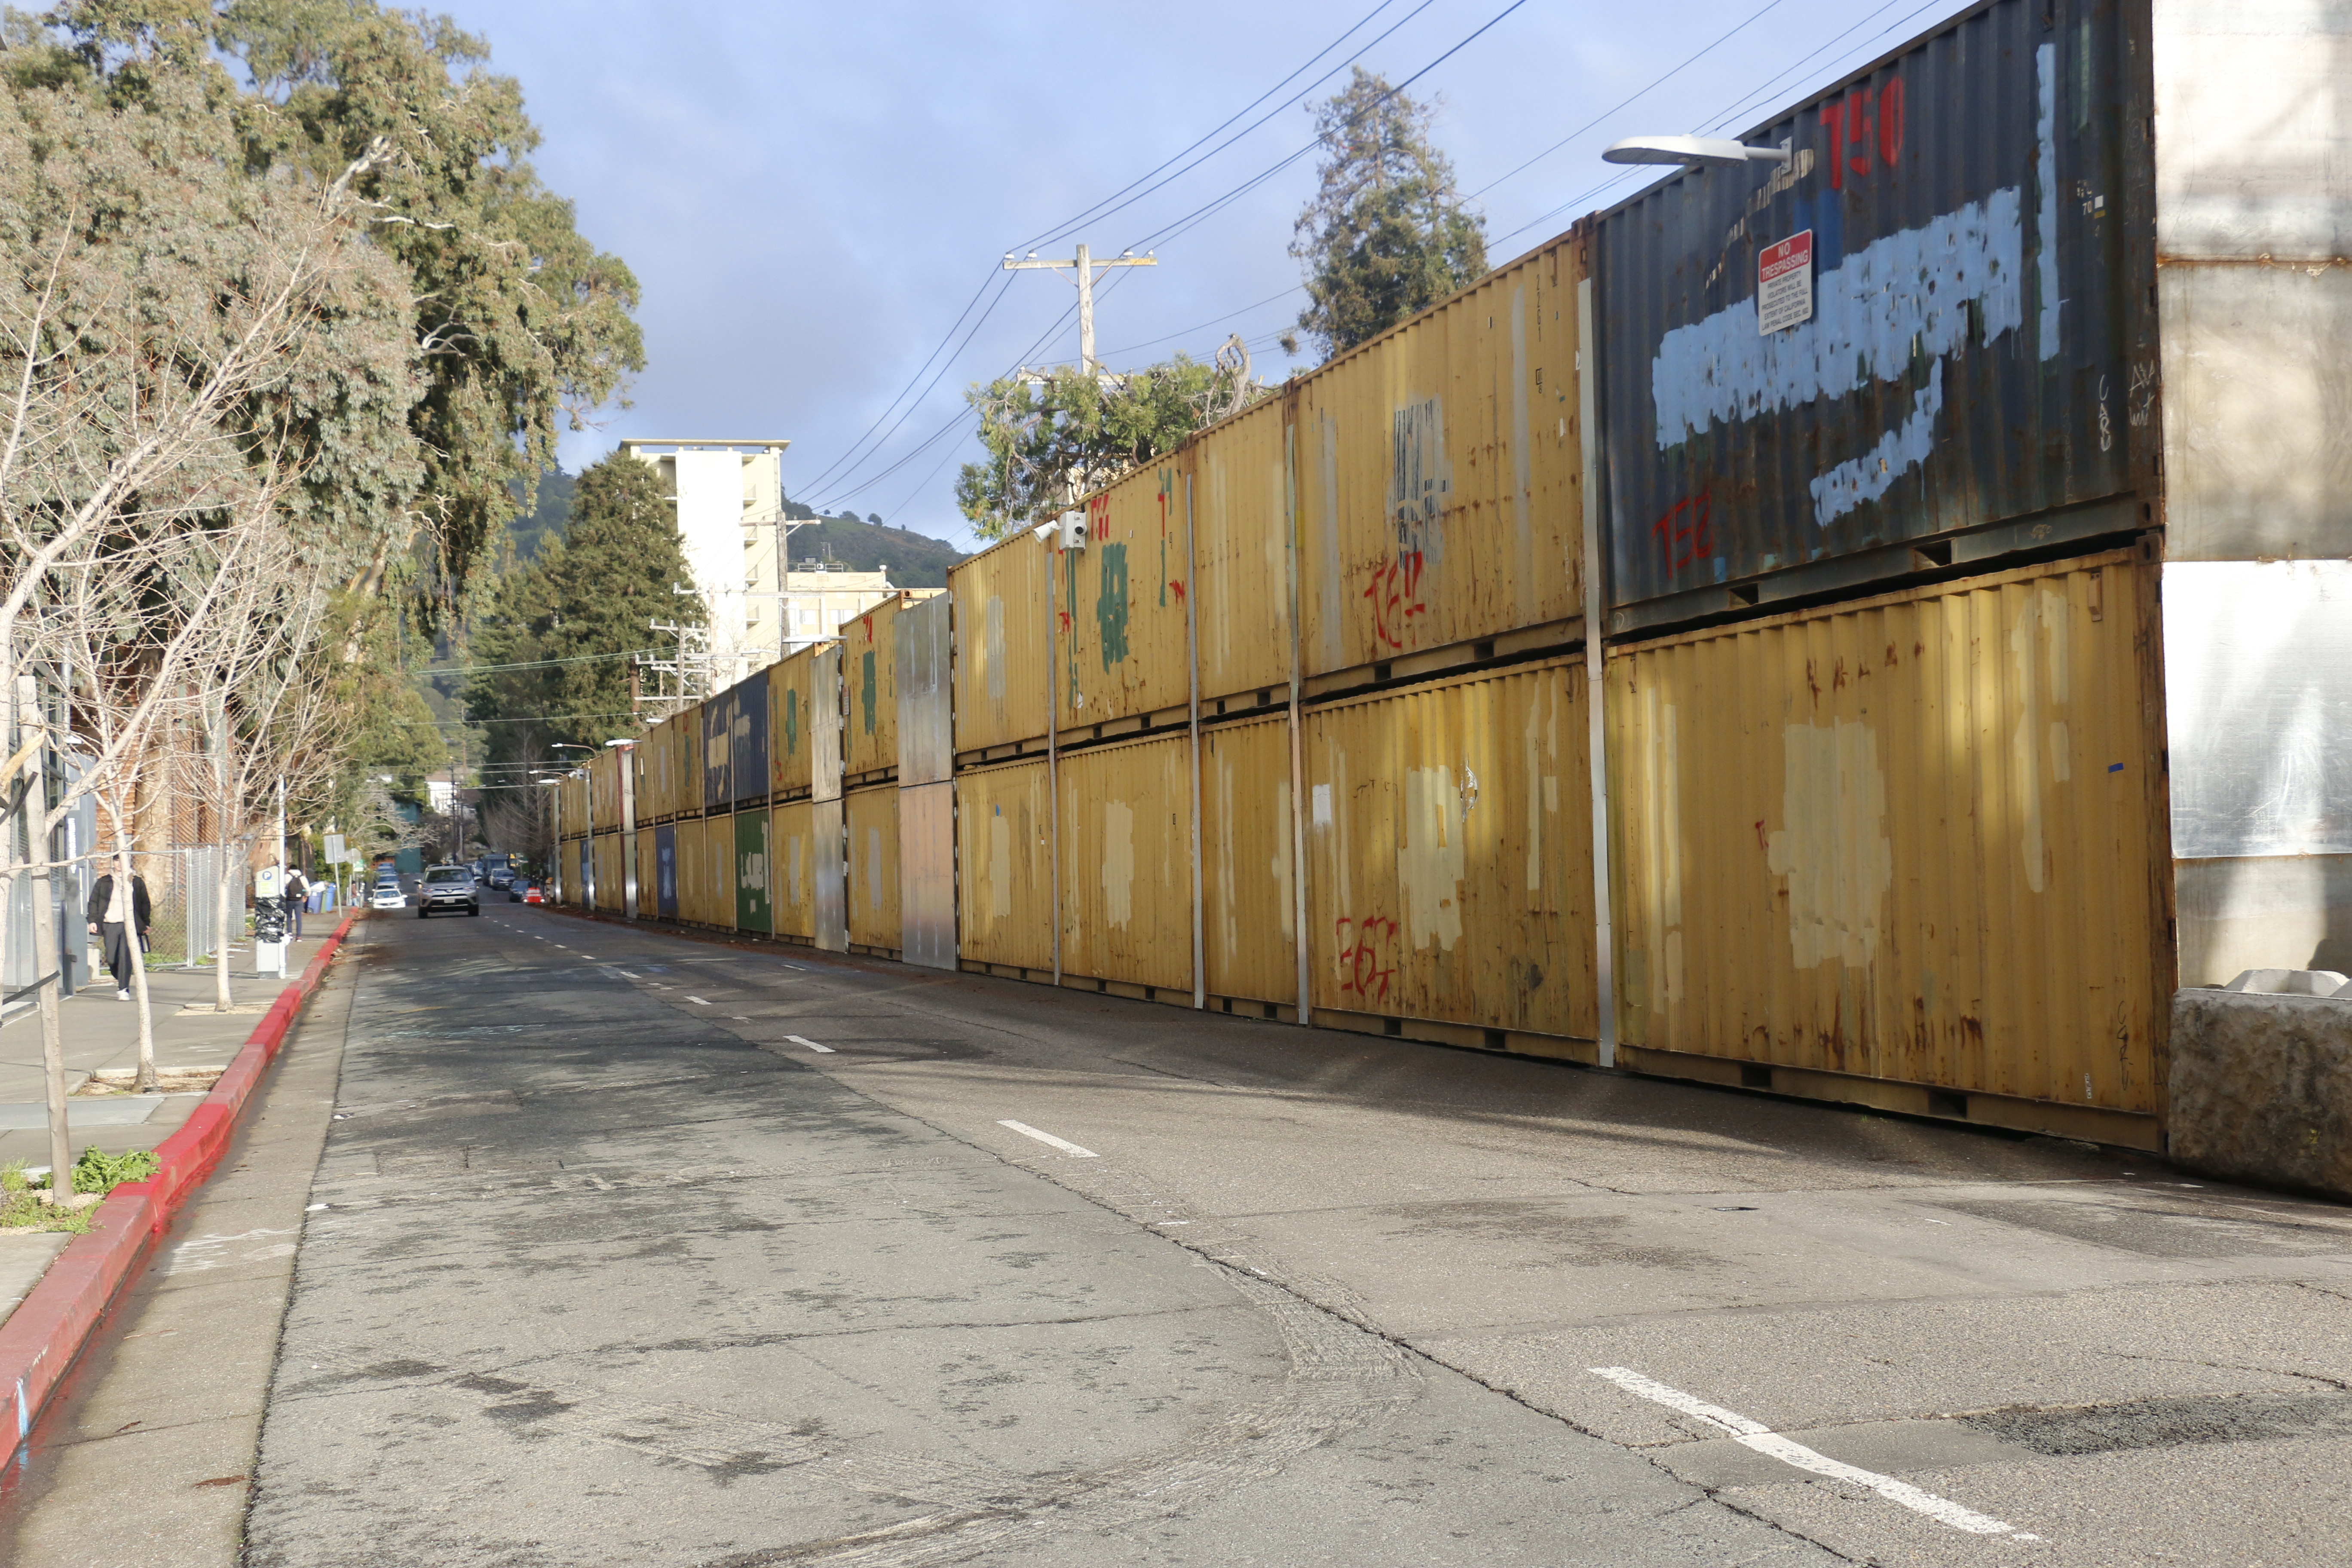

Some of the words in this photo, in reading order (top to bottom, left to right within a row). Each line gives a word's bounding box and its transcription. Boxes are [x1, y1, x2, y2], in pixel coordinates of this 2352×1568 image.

[1778, 242, 1790, 258] NO
[1762, 249, 1808, 280] TRESPASSING
[1767, 279, 1782, 290] PRIVATE
[1782, 270, 1801, 282] PROPERTY
[1767, 286, 1787, 299] VIOLATORS
[1797, 279, 1802, 288] BE
[1761, 297, 1785, 310] PROSECUTED
[1799, 287, 1808, 296] FULL
[1764, 309, 1778, 320] EXTENT
[1784, 297, 1805, 312] CALIFORNIA
[1770, 318, 1782, 326] PENAL
[1782, 313, 1793, 323] CODE
[1793, 309, 1802, 318] SEC.
